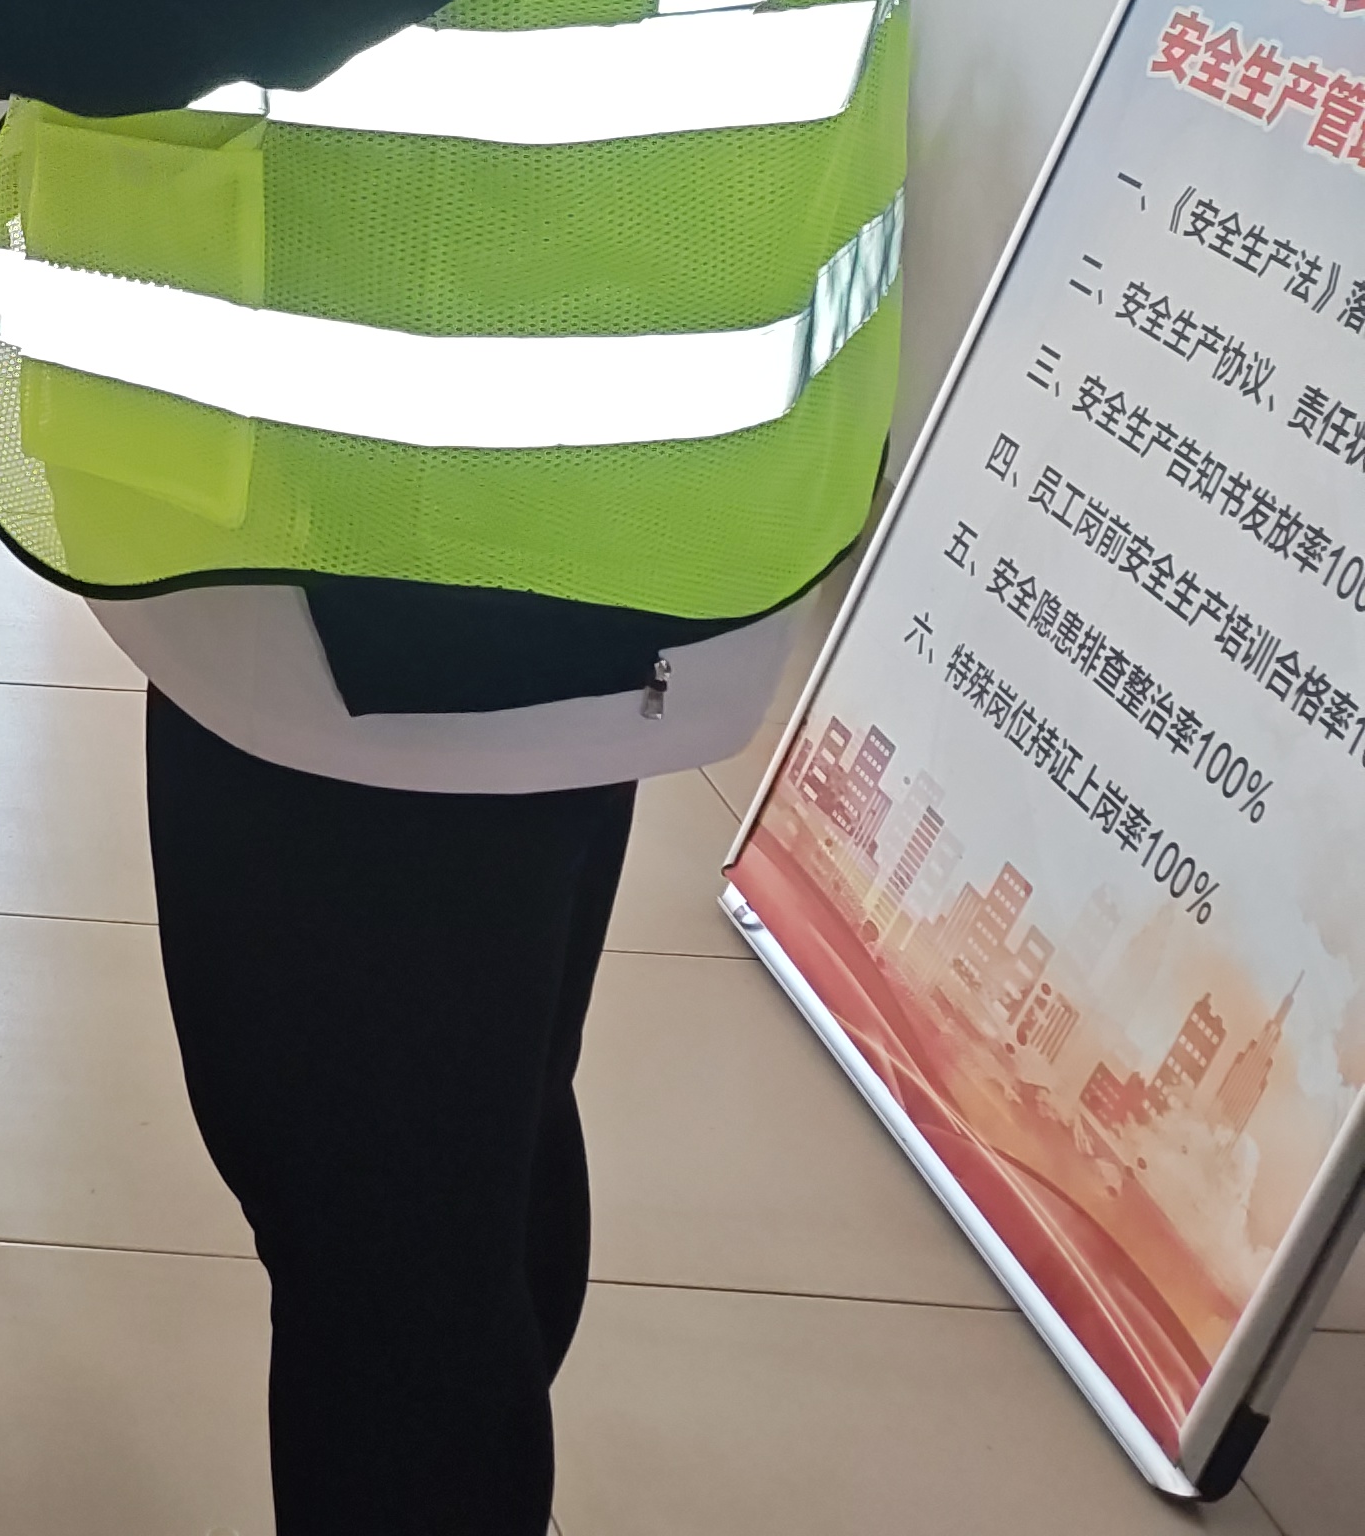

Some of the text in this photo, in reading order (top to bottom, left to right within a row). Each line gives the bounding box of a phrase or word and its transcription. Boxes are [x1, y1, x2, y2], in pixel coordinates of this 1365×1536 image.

[944, 521, 1276, 824] 五、安全隐患排查整治率100%
[984, 432, 1365, 768] 四、员工岗前安全生产培训合格率1
[904, 610, 1223, 926] 六、特殊岗位持证上岗率100%
